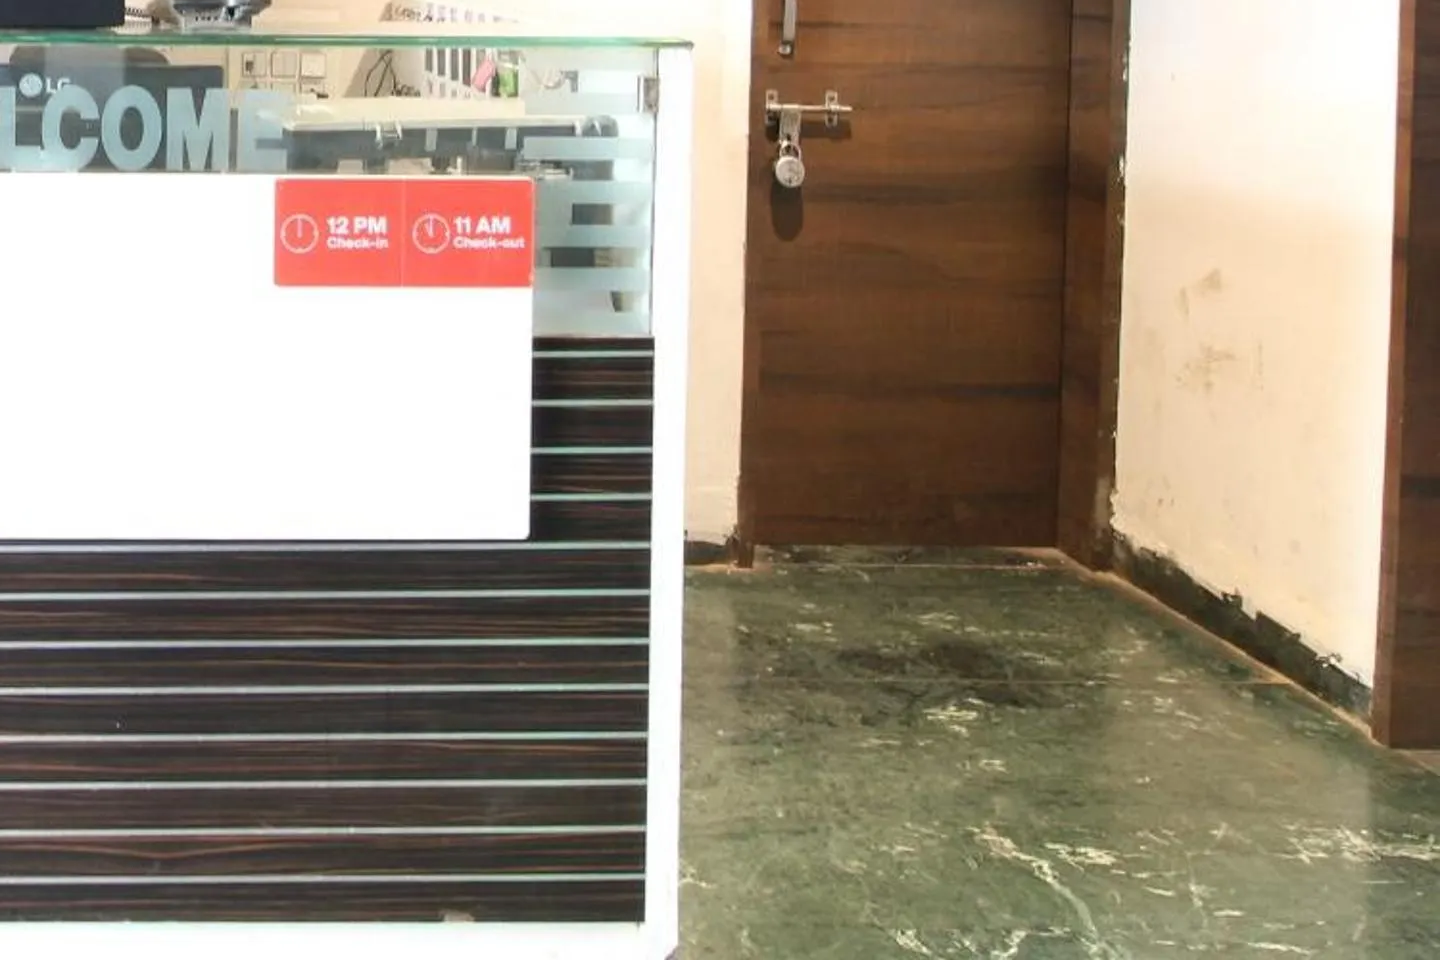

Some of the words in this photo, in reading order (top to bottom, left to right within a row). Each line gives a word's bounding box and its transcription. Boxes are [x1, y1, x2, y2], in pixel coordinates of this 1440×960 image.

[327, 216, 350, 235] 12
[353, 216, 388, 235] PM
[454, 216, 472, 235] 11
[475, 216, 512, 235] AM
[326, 235, 389, 250] Check-in
[453, 235, 526, 250] Check-out
